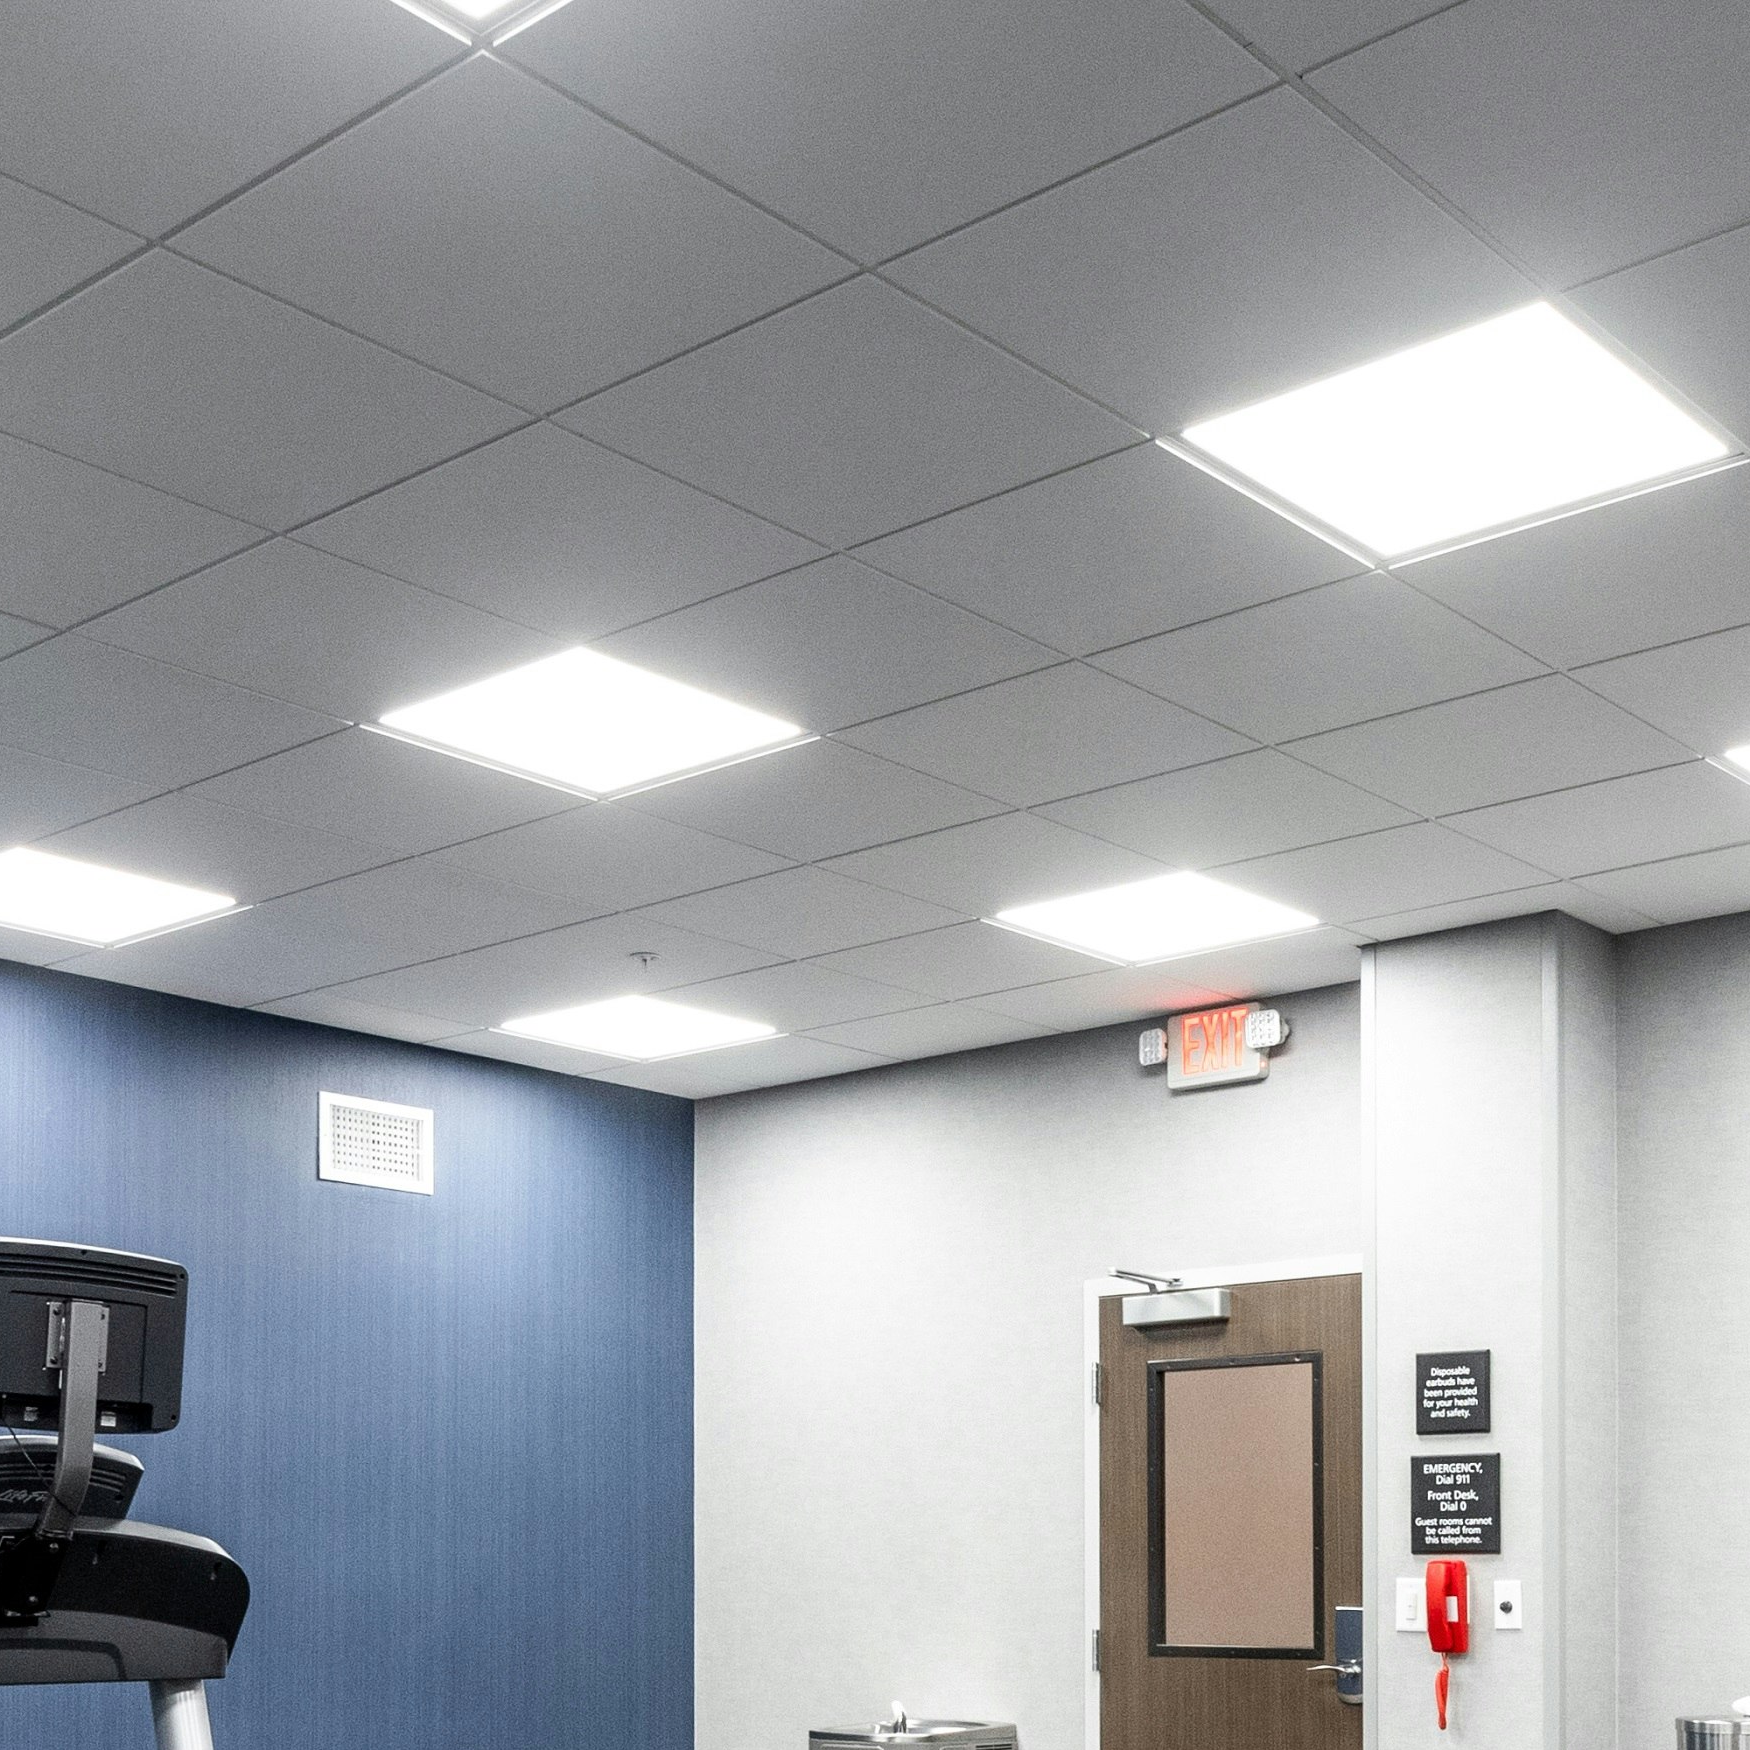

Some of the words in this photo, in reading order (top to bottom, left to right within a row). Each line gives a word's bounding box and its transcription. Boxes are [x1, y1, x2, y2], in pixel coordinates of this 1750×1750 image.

[1182, 1008, 1247, 1074] EXIT
[1430, 1365, 1470, 1377] Disposable
[1426, 1377, 1456, 1387] earbuds
[1456, 1376, 1476, 1386] have
[1423, 1388, 1443, 1398] been
[1444, 1386, 1478, 1398] provided
[1423, 1399, 1435, 1408] for
[1435, 1400, 1453, 1409] your
[1454, 1397, 1479, 1407] health
[1430, 1408, 1446, 1418] and
[1423, 1462, 1483, 1474] EMERGENCY,
[1435, 1474, 1454, 1485] Dial
[1455, 1474, 1470, 1484] 911
[1427, 1490, 1452, 1501] Front
[1453, 1489, 1479, 1501] Desk,
[1440, 1501, 1458, 1512] Dial
[1459, 1501, 1467, 1511] 0
[1415, 1517, 1438, 1526] Guest
[1438, 1518, 1464, 1526] rooms
[1464, 1517, 1492, 1526] cannot
[1425, 1526, 1437, 1535] be
[1437, 1526, 1461, 1535] called
[1461, 1526, 1482, 1534] from
[1424, 1535, 1440, 1544] this
[1440, 1535, 1483, 1546] telephone.
